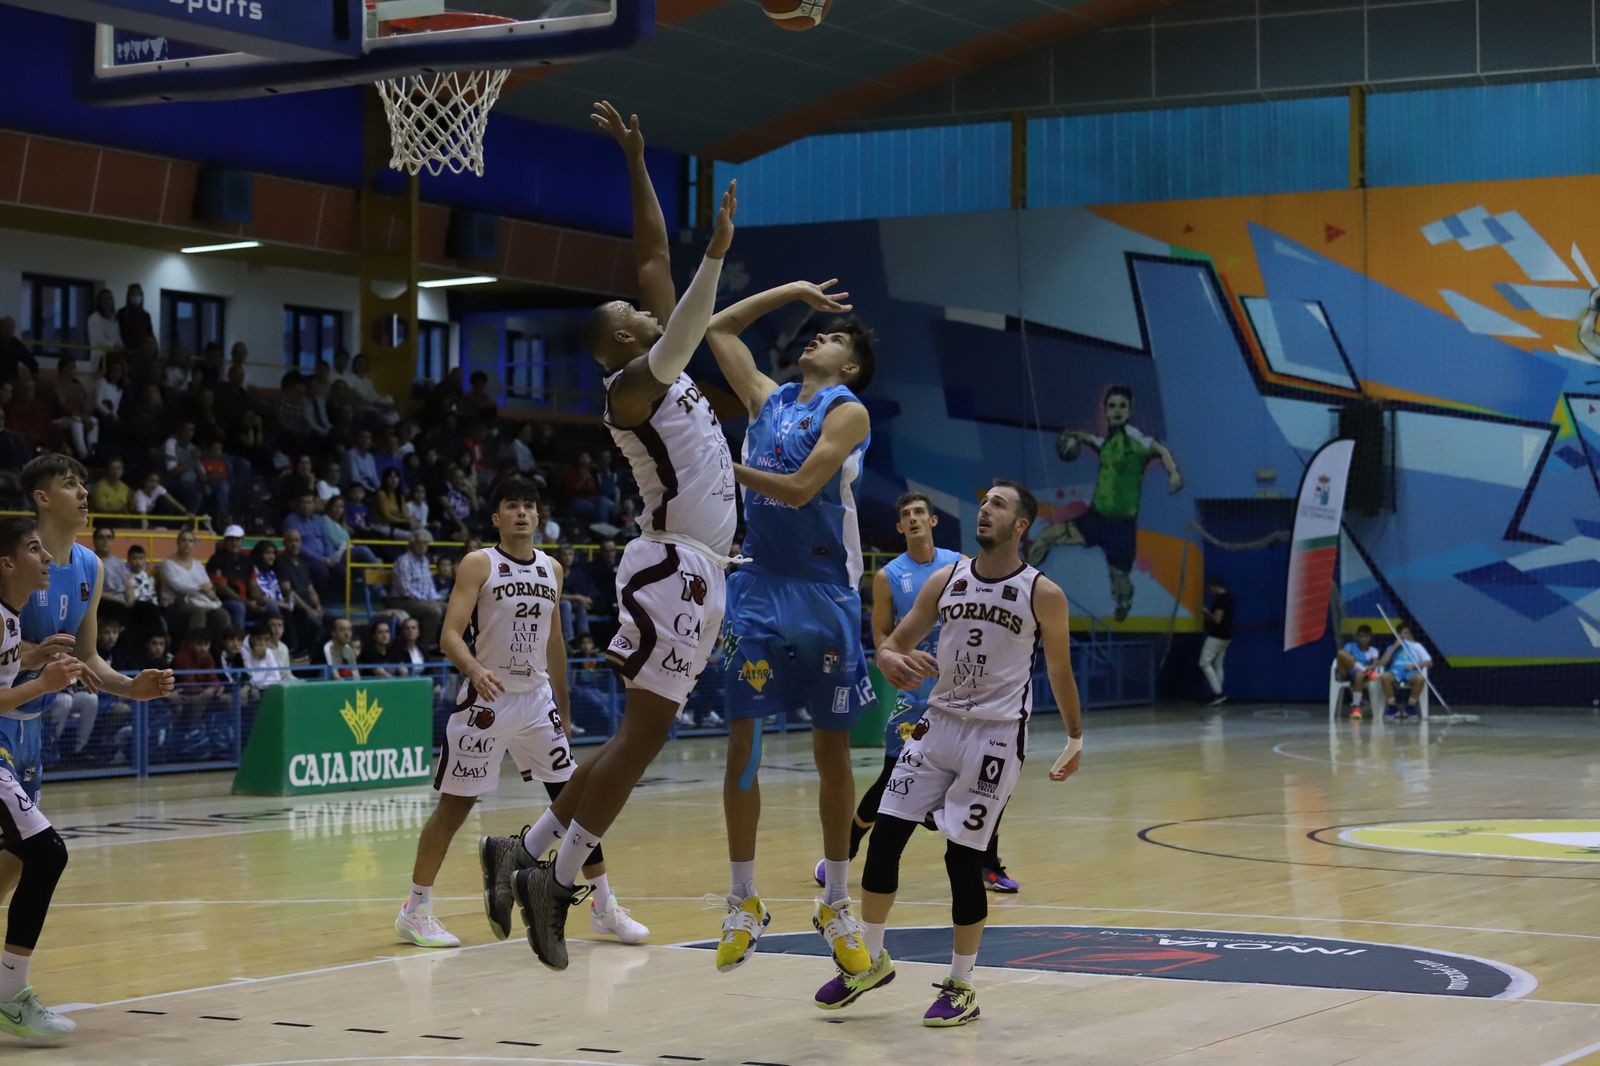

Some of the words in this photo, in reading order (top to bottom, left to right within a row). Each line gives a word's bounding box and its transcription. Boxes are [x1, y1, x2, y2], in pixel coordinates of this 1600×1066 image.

[169, 0, 263, 20] ports
[493, 582, 556, 603] TORMES
[60, 594, 69, 621] 8
[515, 602, 542, 618] 24
[512, 621, 526, 631] LA
[941, 602, 1023, 635] TORMES
[967, 629, 983, 647] 3
[954, 649, 972, 663] LA
[856, 675, 877, 707] 12
[459, 735, 496, 753] GAC
[288, 751, 349, 787] CAJA
[350, 746, 430, 782] RURAL
[549, 746, 574, 771] 2
[963, 803, 988, 831] 3
[1159, 938, 1367, 956] INNOVA
